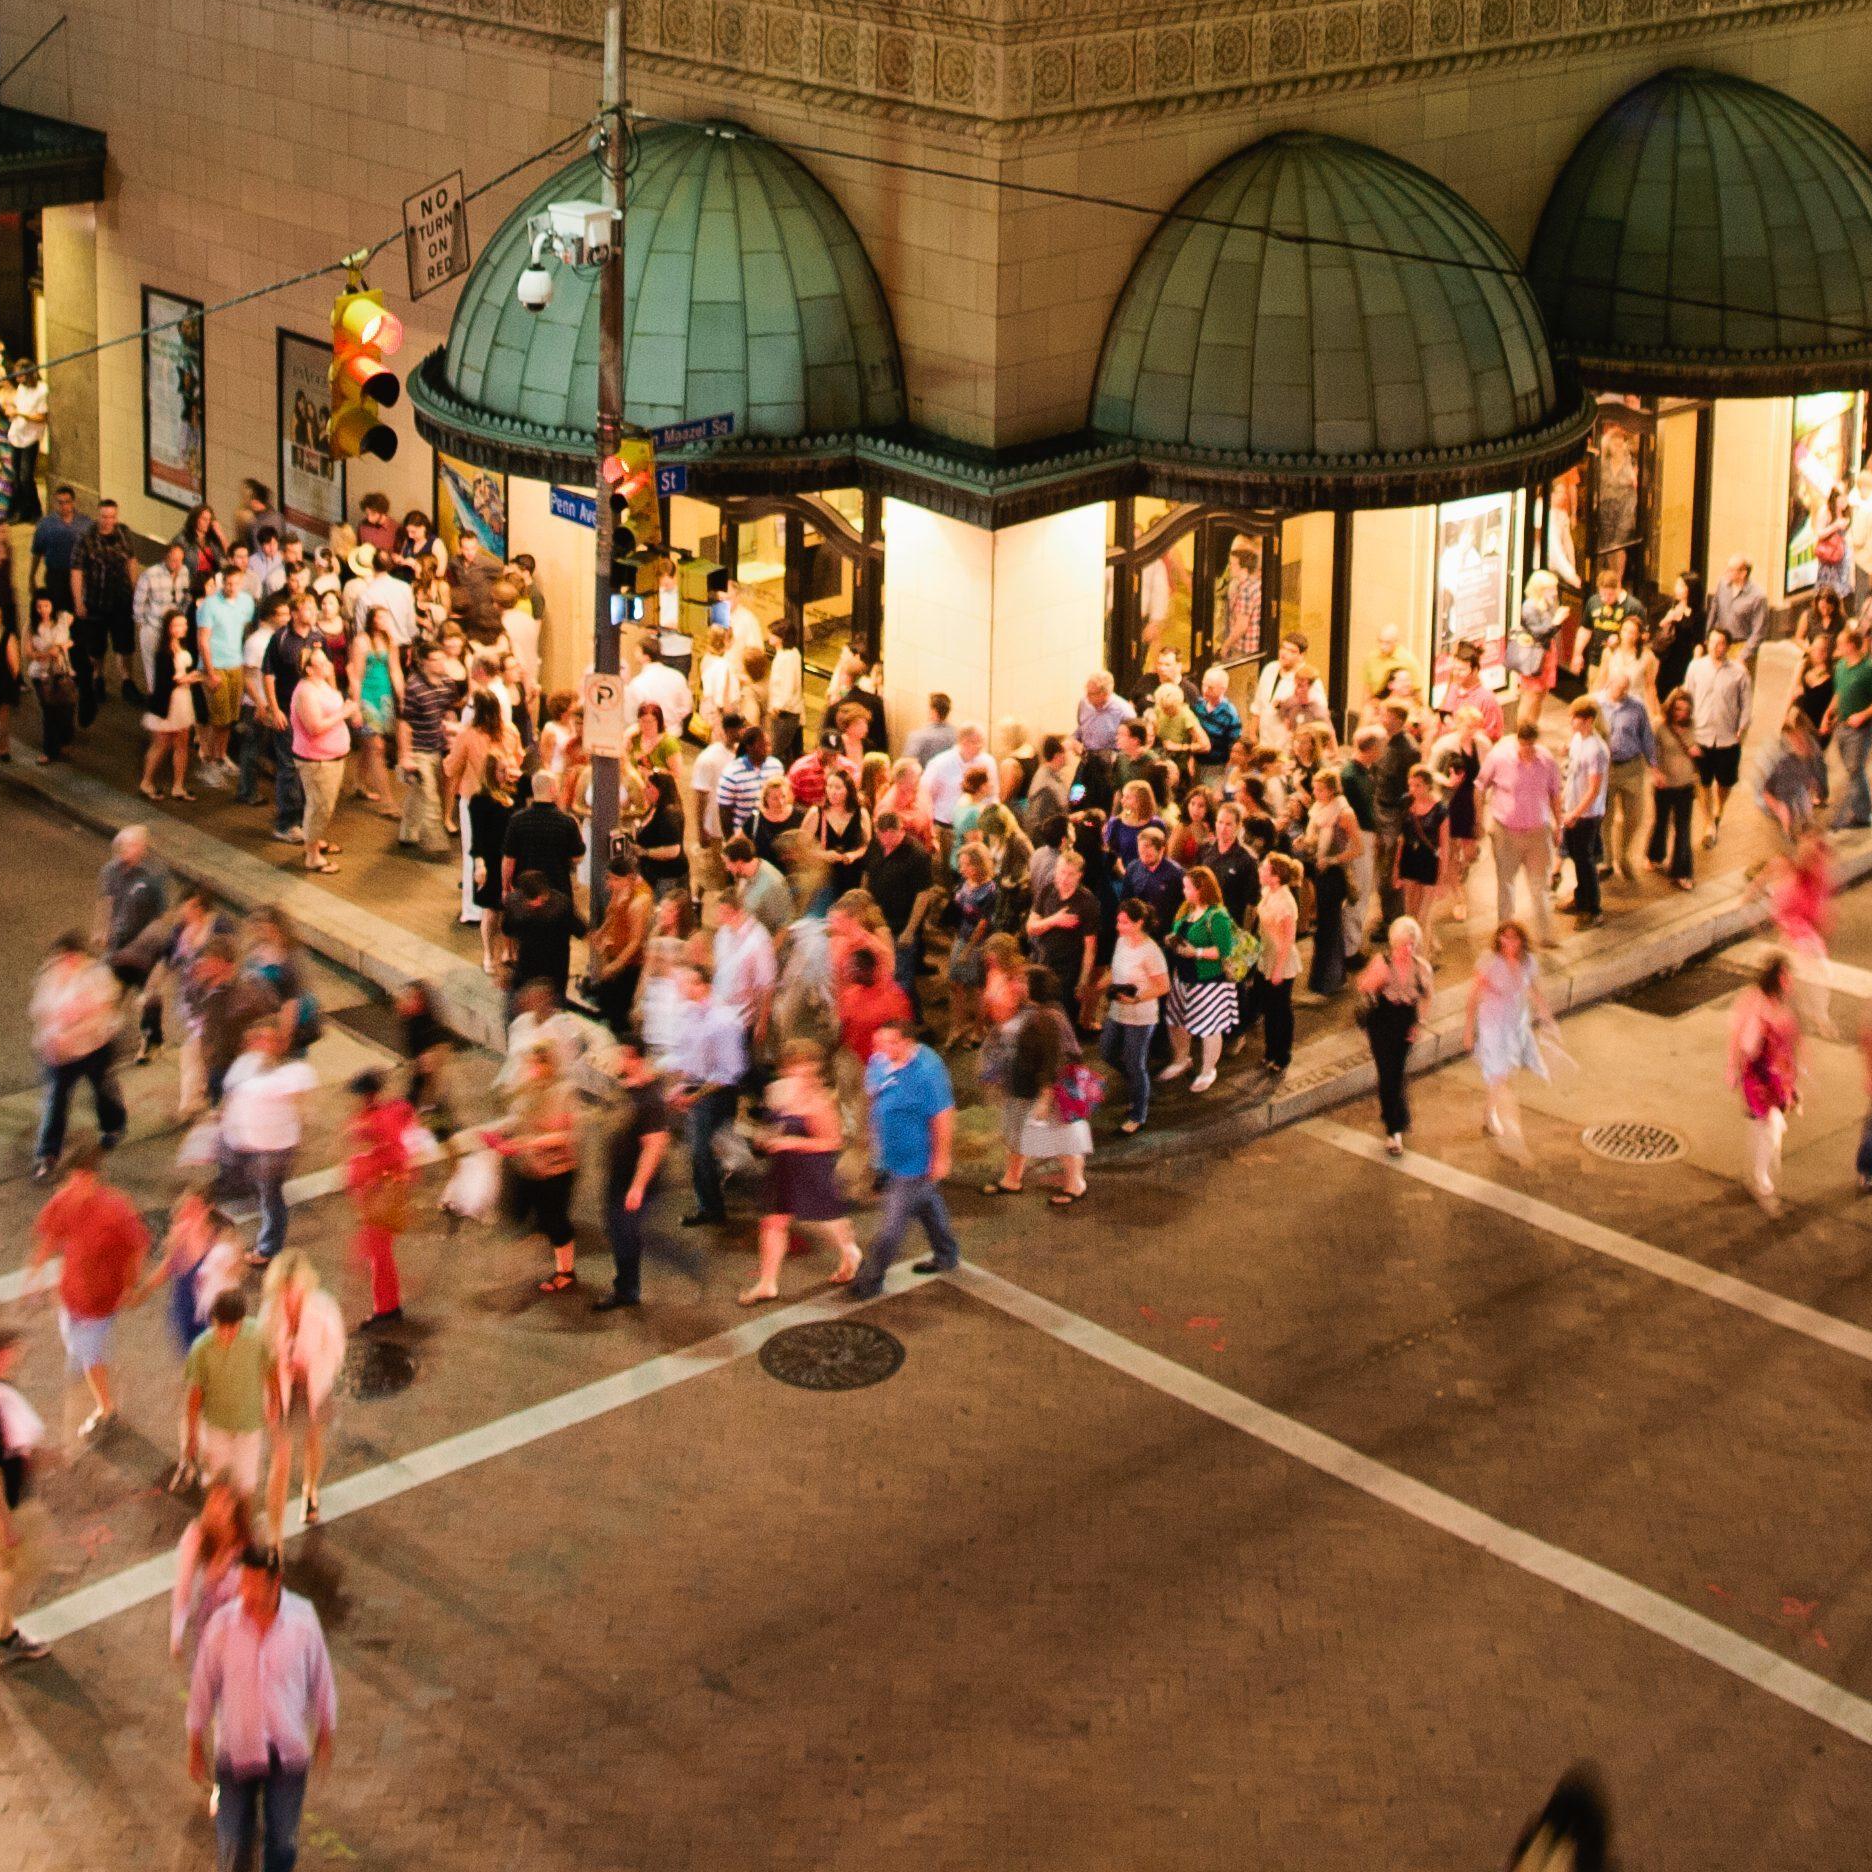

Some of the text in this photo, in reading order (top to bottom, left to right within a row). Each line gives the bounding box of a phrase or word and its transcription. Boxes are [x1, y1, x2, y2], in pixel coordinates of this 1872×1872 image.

[420, 188, 448, 218] NO
[418, 209, 453, 241] TURN
[428, 236, 448, 259] ON
[427, 255, 453, 282] RED
[661, 471, 676, 491] St
[551, 491, 576, 518] Penn
